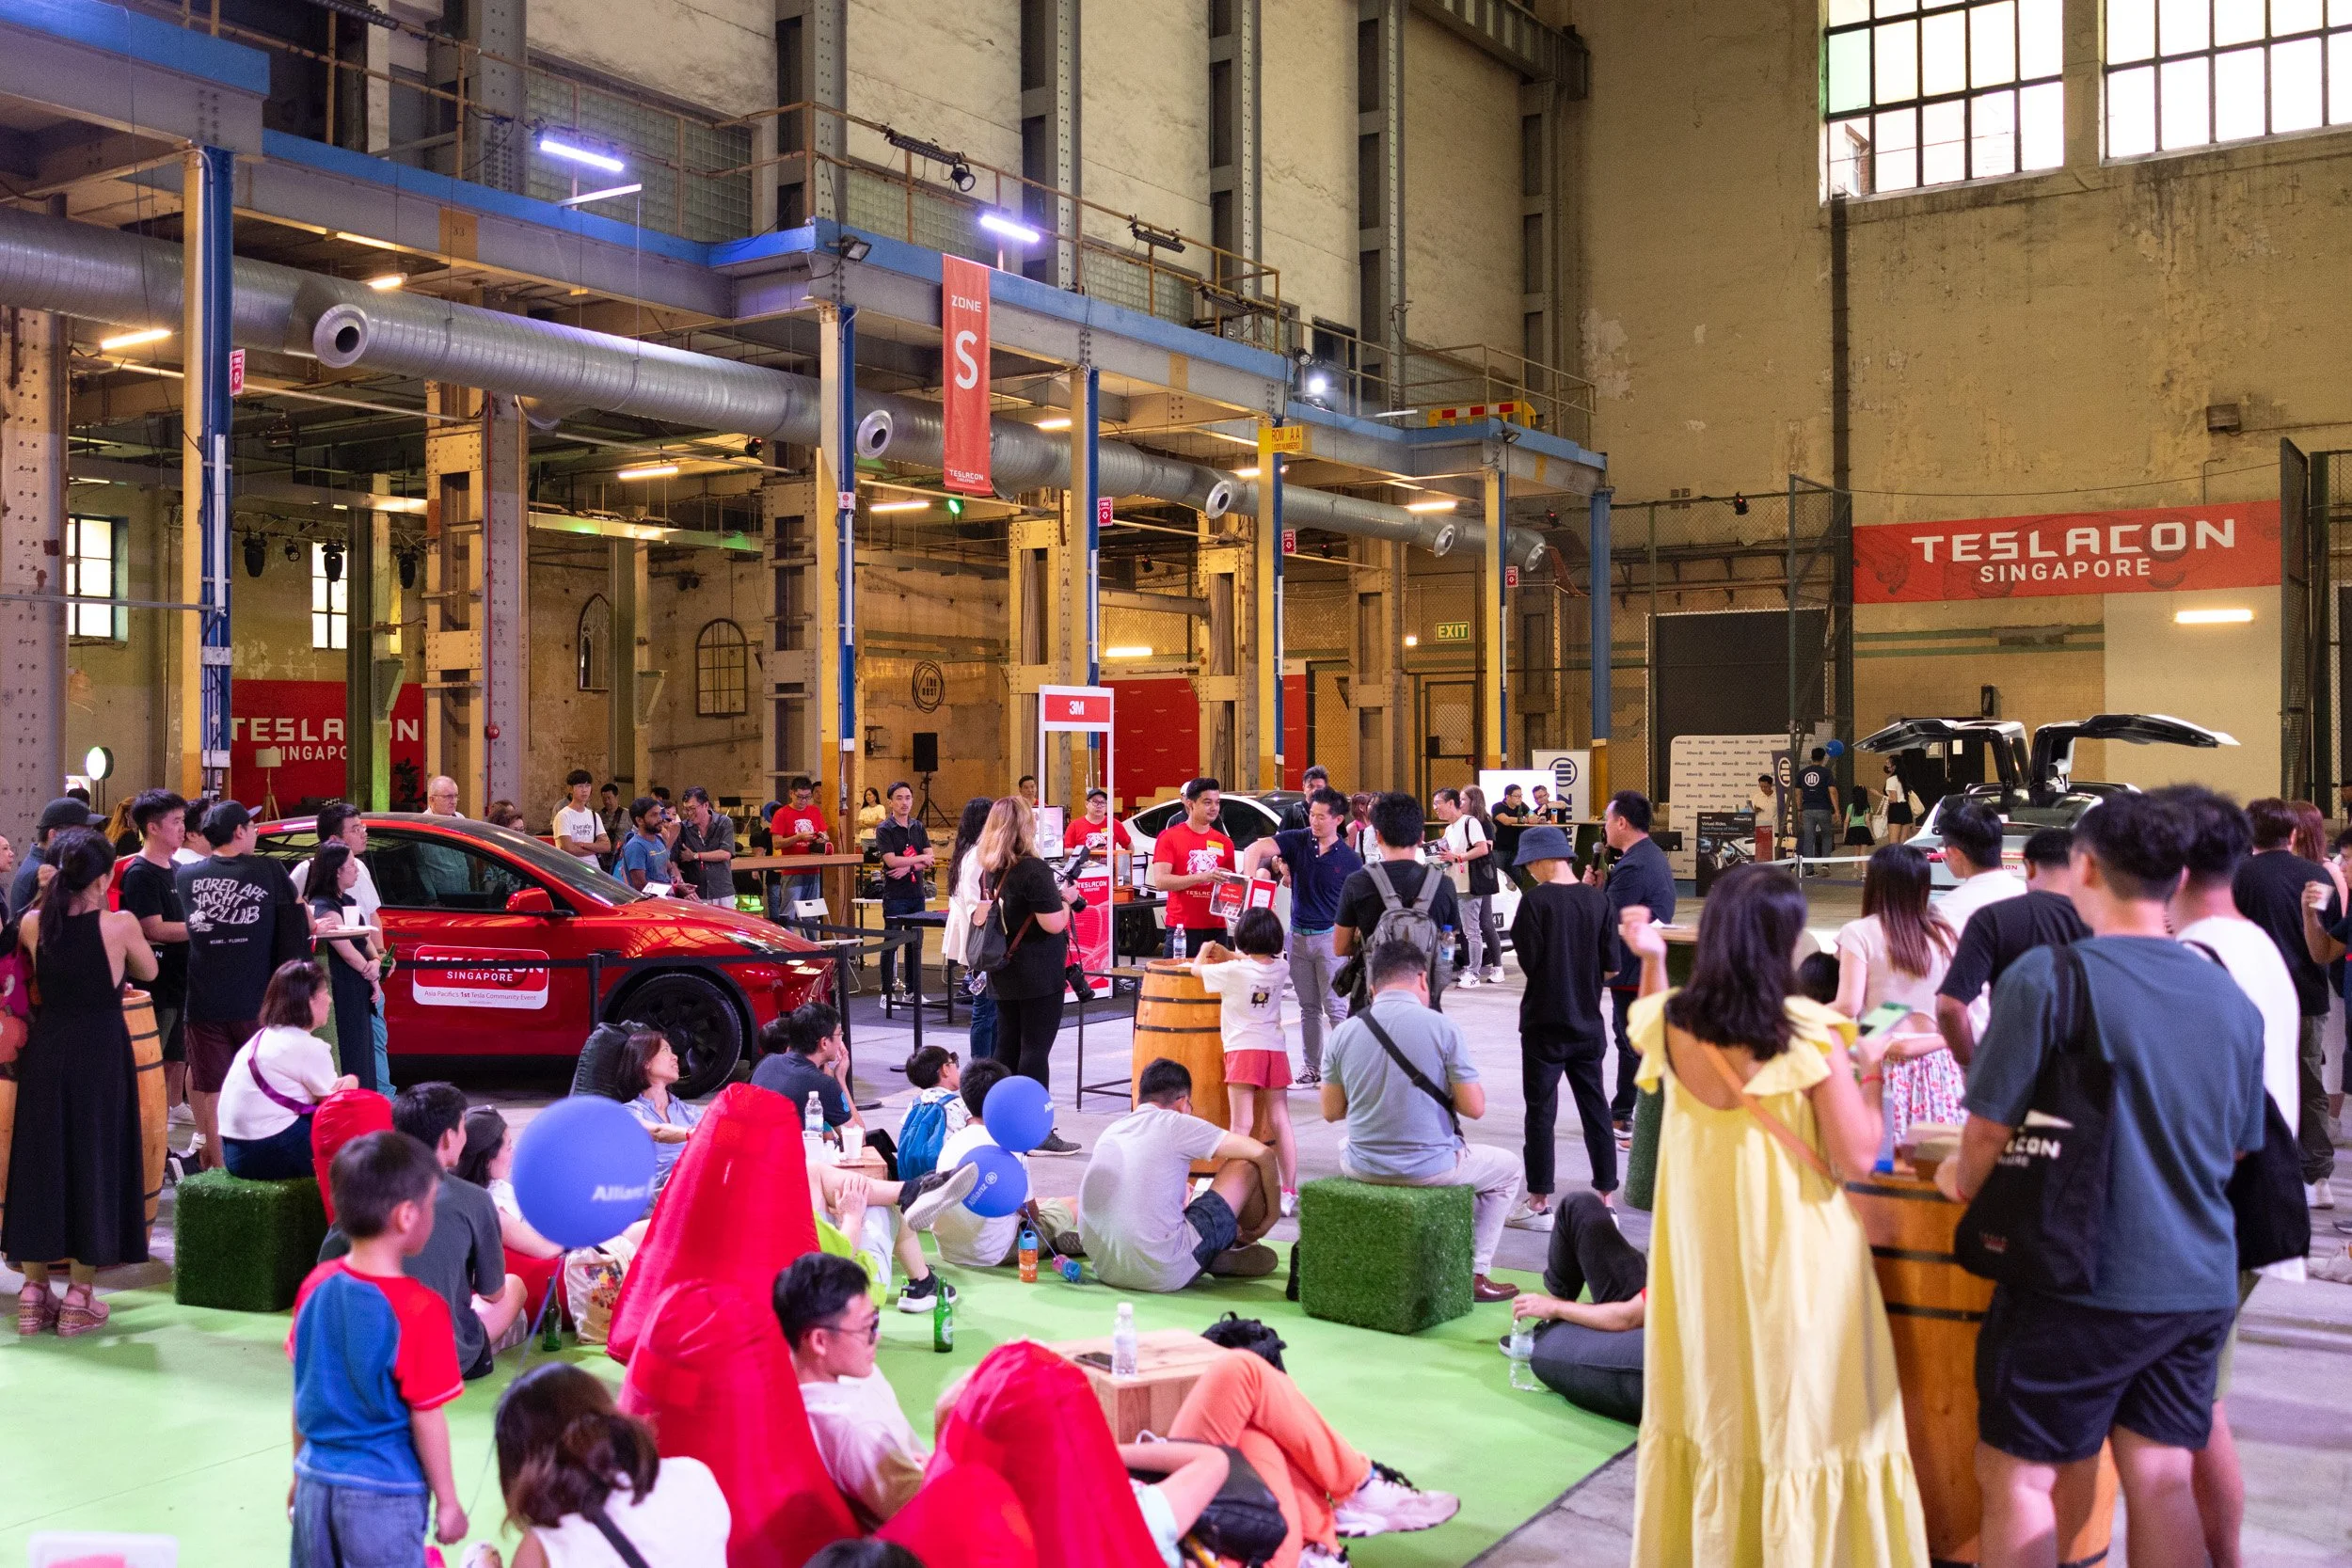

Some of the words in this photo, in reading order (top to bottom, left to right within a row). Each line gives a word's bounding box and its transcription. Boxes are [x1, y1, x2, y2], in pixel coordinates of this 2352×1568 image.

[951, 295, 982, 312] ZONE
[955, 330, 978, 390] S
[1272, 428, 1285, 442] ROW
[949, 470, 984, 480] TESLACON
[1911, 519, 2234, 563] TESLACON
[1980, 558, 2151, 583] SINGAPORE
[1438, 624, 1467, 638] EXIT
[1069, 700, 1084, 715] 3M
[231, 718, 419, 742] TESLAN
[192, 878, 239, 893] BORED
[239, 883, 269, 902] APE
[192, 891, 248, 909] YACHT
[207, 904, 260, 924] CLUB
[447, 971, 513, 982] SINGAPORE
[968, 1183, 988, 1206] Allianz
